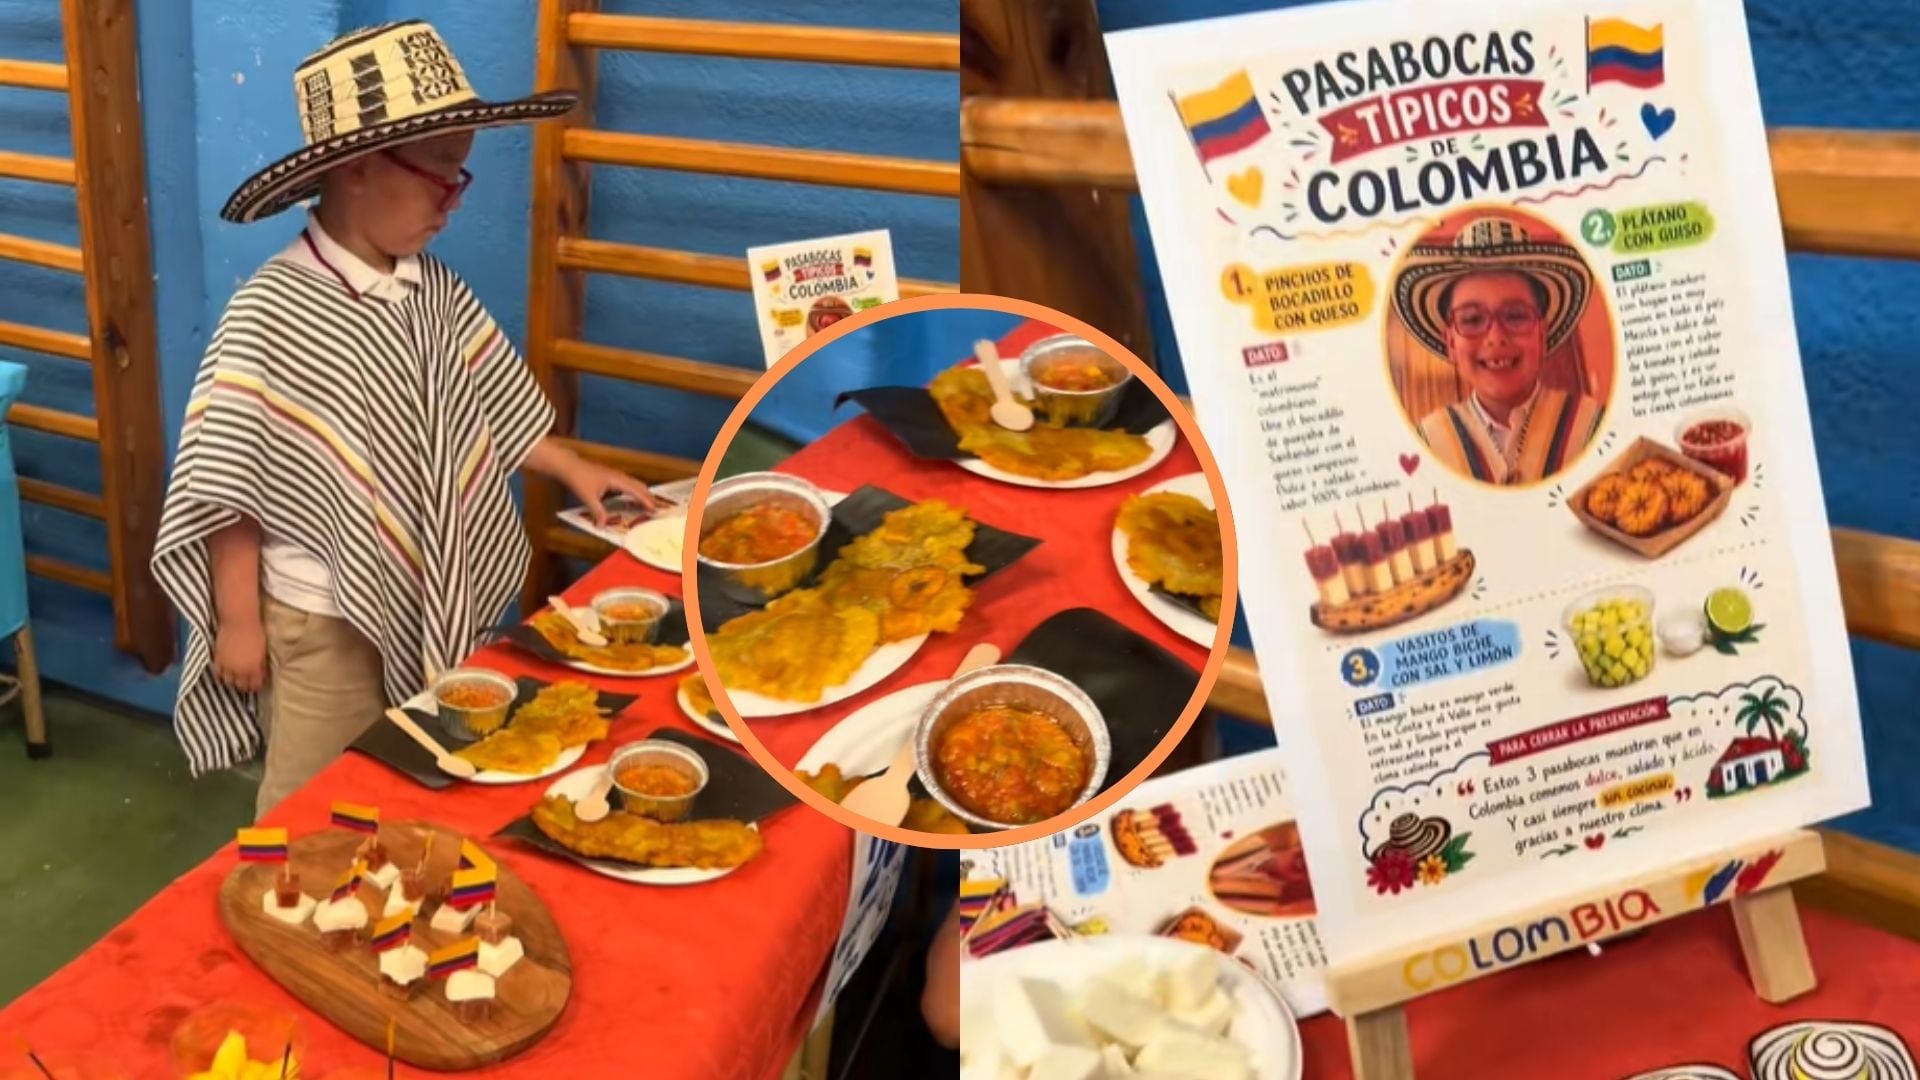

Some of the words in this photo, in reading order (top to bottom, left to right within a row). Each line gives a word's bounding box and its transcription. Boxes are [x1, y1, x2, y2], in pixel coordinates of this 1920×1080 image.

[1282, 30, 1535, 115] PASABOCAS
[1356, 84, 1512, 144] TÍPICOS
[1431, 137, 1458, 158] DE
[1307, 127, 1608, 223] COLOMBIA
[1622, 205, 1687, 231] PLÁTANO
[1624, 232, 1654, 249] CON
[1659, 221, 1703, 242] GUISO
[789, 276, 858, 300] COLOMBIA
[1265, 269, 1331, 292] PINCHOS
[1335, 264, 1354, 280] DE
[1270, 284, 1354, 311] BOCADILLO
[1274, 314, 1306, 330] CON
[1310, 303, 1359, 324] QUESO
[1395, 630, 1455, 652] VASITOS
[1461, 623, 1478, 638] DE
[1391, 670, 1420, 687] CON
[1424, 664, 1448, 680] SAL
[1456, 659, 1463, 671] Y
[1469, 645, 1513, 668] LIMÓN
[1395, 647, 1449, 671] MANGO
[1454, 636, 1493, 653] BICHE
[1375, 712, 1407, 727] mango
[1381, 728, 1391, 738] la
[1436, 713, 1445, 724] el
[1448, 708, 1471, 721] Valle
[1500, 740, 1527, 757] PARA
[1530, 726, 1568, 747] CERRAR
[1571, 722, 1587, 737] LA
[1589, 701, 1660, 730] PRESENTACIÓN
[1389, 739, 1402, 750] sal
[1429, 743, 1450, 757] para
[1483, 775, 1520, 795] Estos
[1527, 765, 1537, 783] 3
[1542, 754, 1600, 783] pasabocas
[1605, 736, 1658, 760] muestran
[1662, 731, 1682, 749] que
[1688, 726, 1702, 737] en
[1469, 794, 1525, 820] Colombia
[1529, 779, 1581, 802] comemos
[1627, 755, 1665, 775] salado
[1669, 755, 1677, 767] y
[1507, 815, 1517, 832] Y
[1523, 811, 1546, 828] casi
[1553, 798, 1597, 819] siempre
[1602, 790, 1622, 806] sin
[1514, 830, 1558, 856] gracias
[1565, 827, 1573, 836] a
[1579, 810, 1625, 832] nuestro
